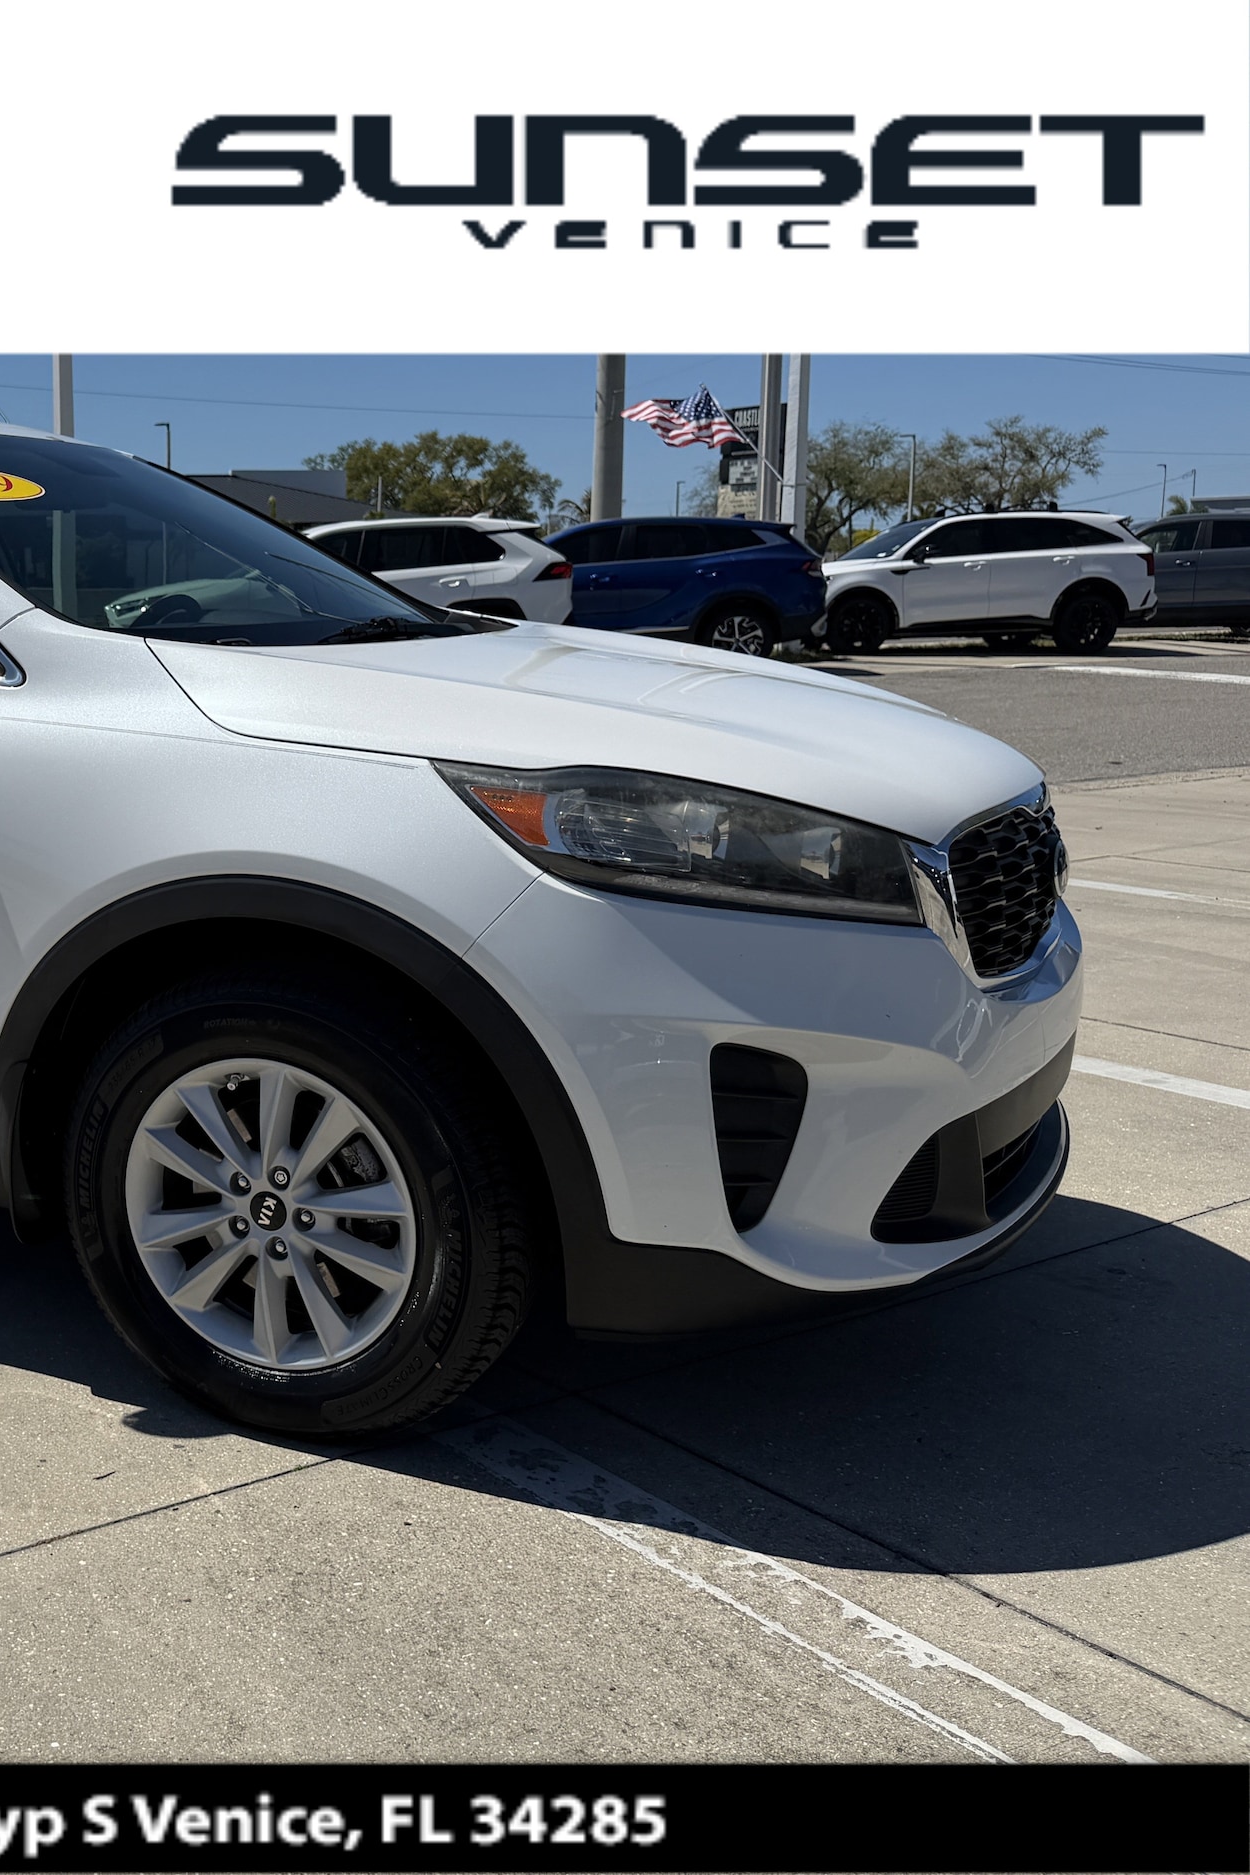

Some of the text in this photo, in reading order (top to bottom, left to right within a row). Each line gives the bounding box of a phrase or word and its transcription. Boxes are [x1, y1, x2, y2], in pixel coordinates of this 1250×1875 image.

[78, 1099, 108, 1211] MICHELIN
[257, 1196, 278, 1226] KIA
[428, 1229, 463, 1348] MICHELIN
